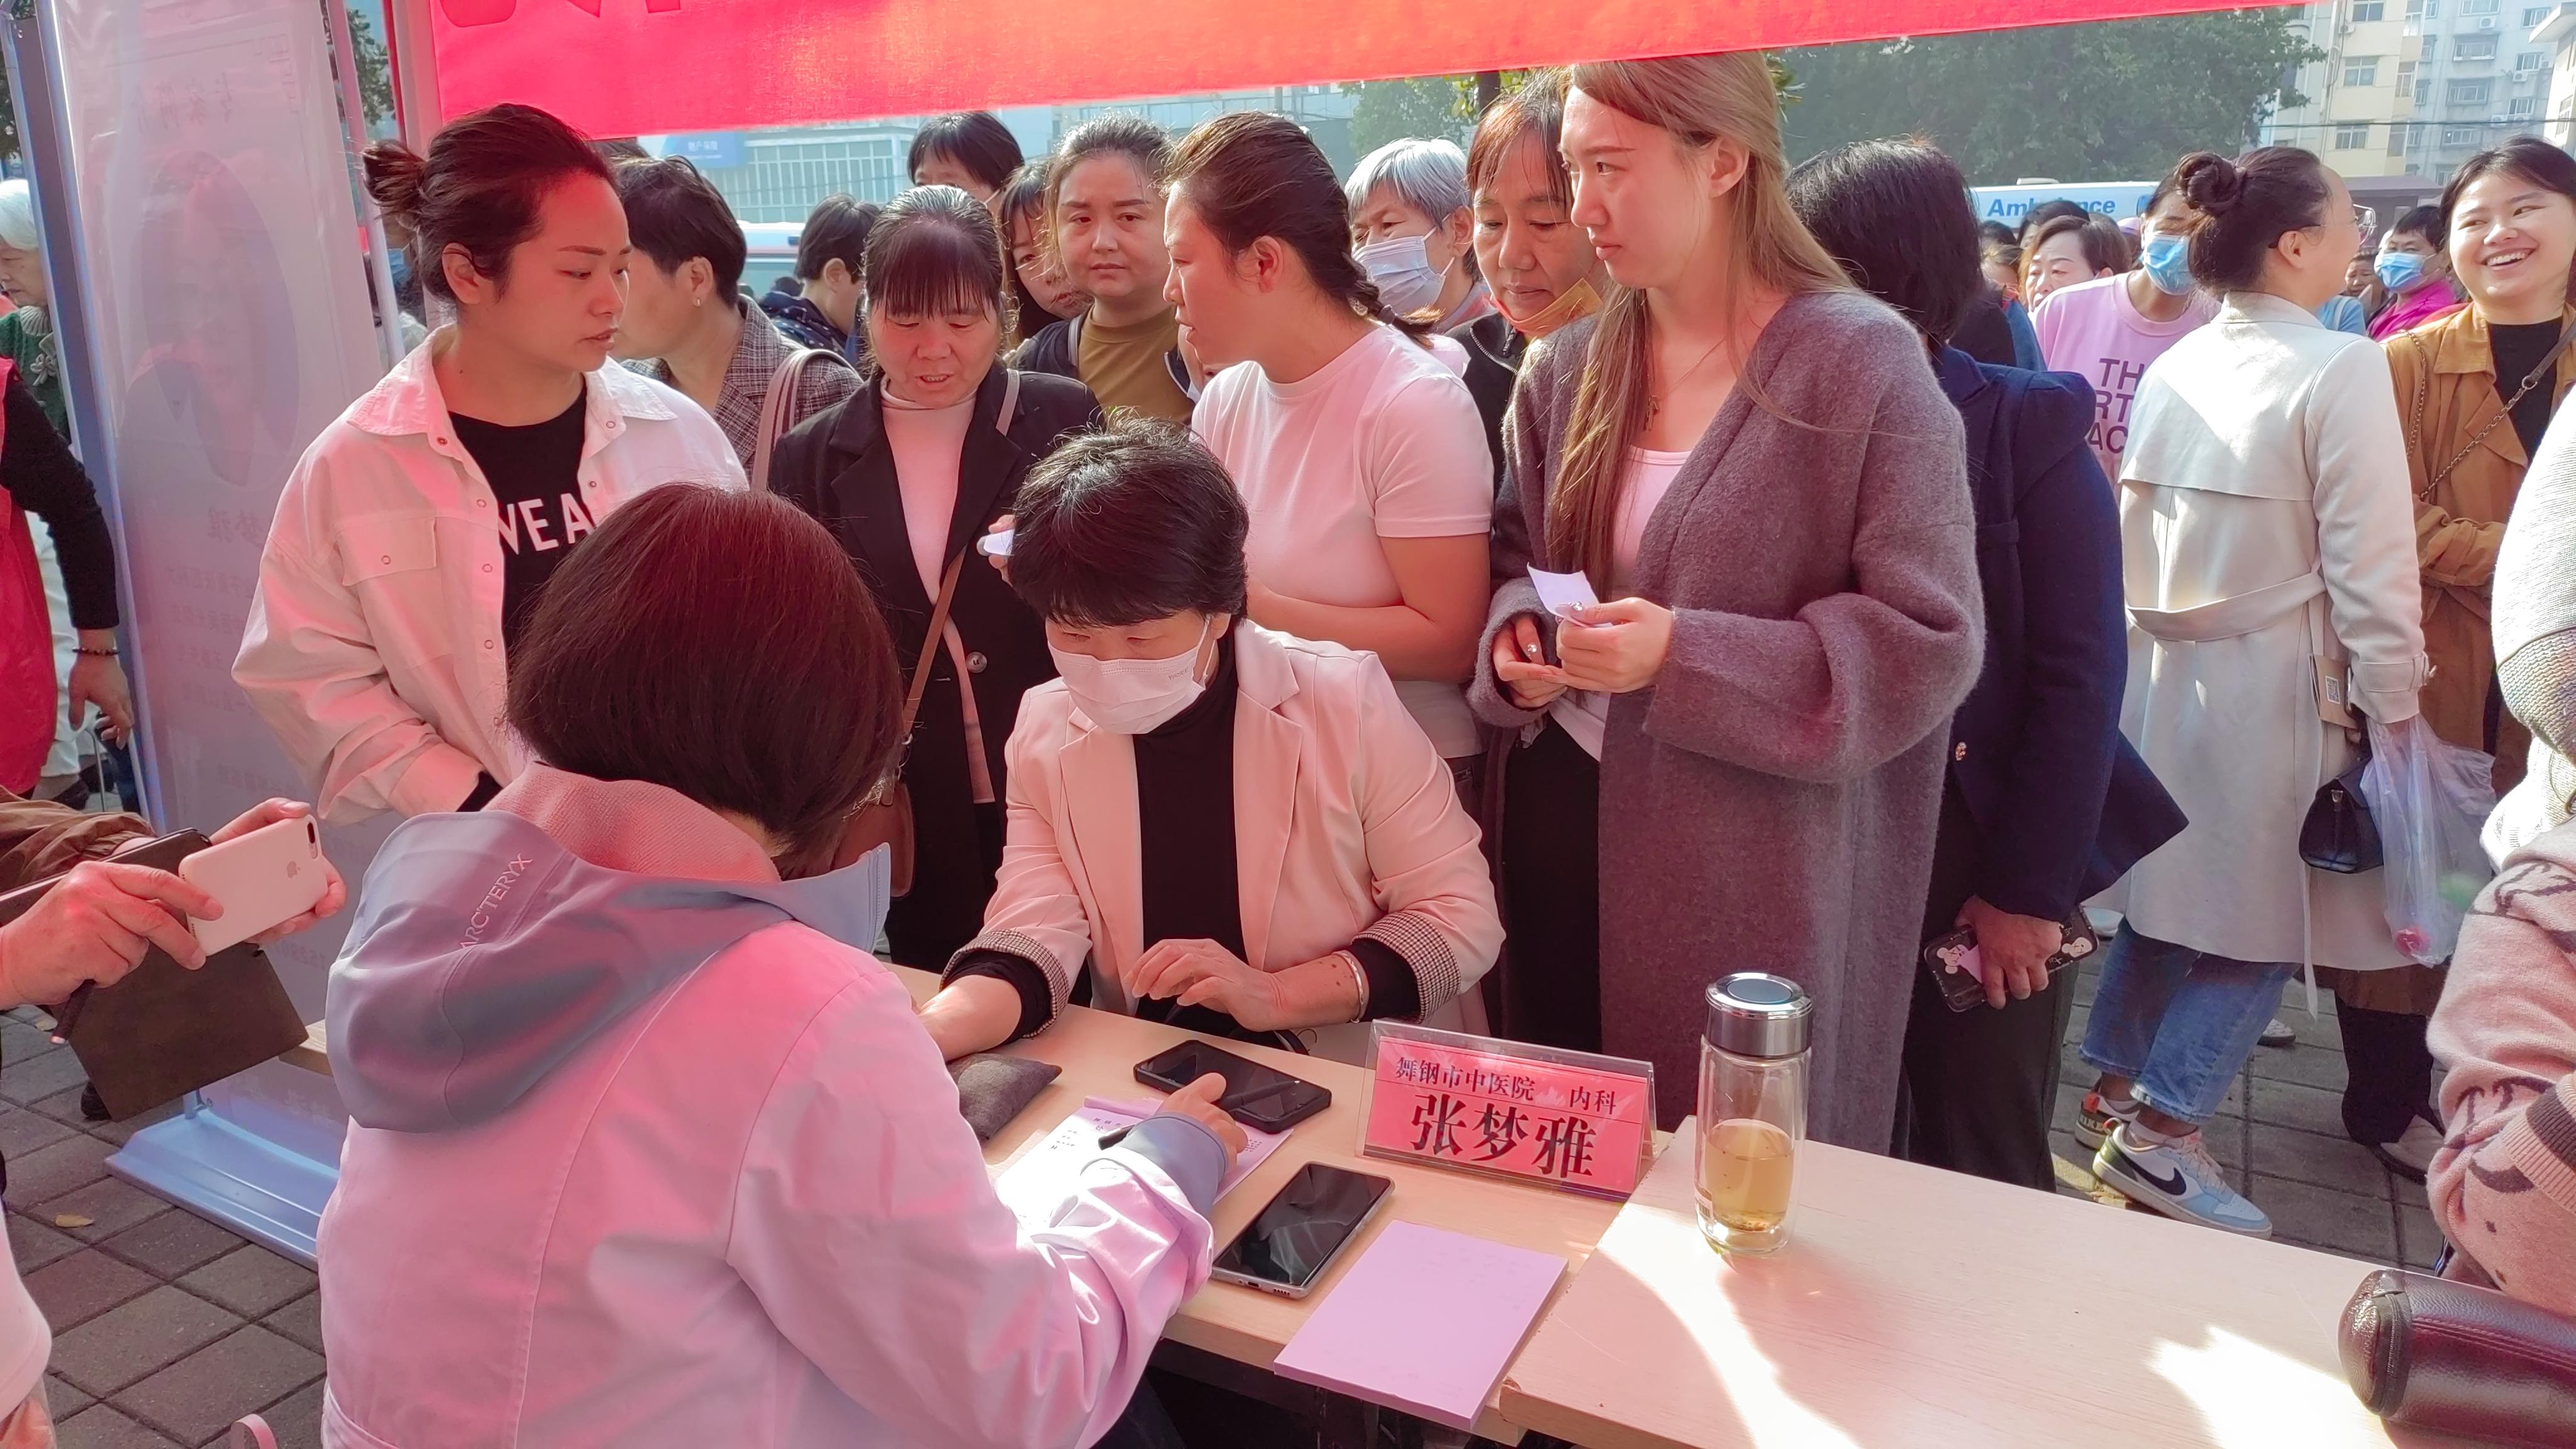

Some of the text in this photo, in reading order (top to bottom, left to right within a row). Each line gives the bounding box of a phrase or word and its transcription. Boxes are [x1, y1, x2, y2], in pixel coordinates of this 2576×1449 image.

[1987, 197, 2115, 217] Amnce
[1396, 1057, 1617, 1115] 舞钢市中医院 内科
[1410, 1094, 1597, 1179] 张梦雅
